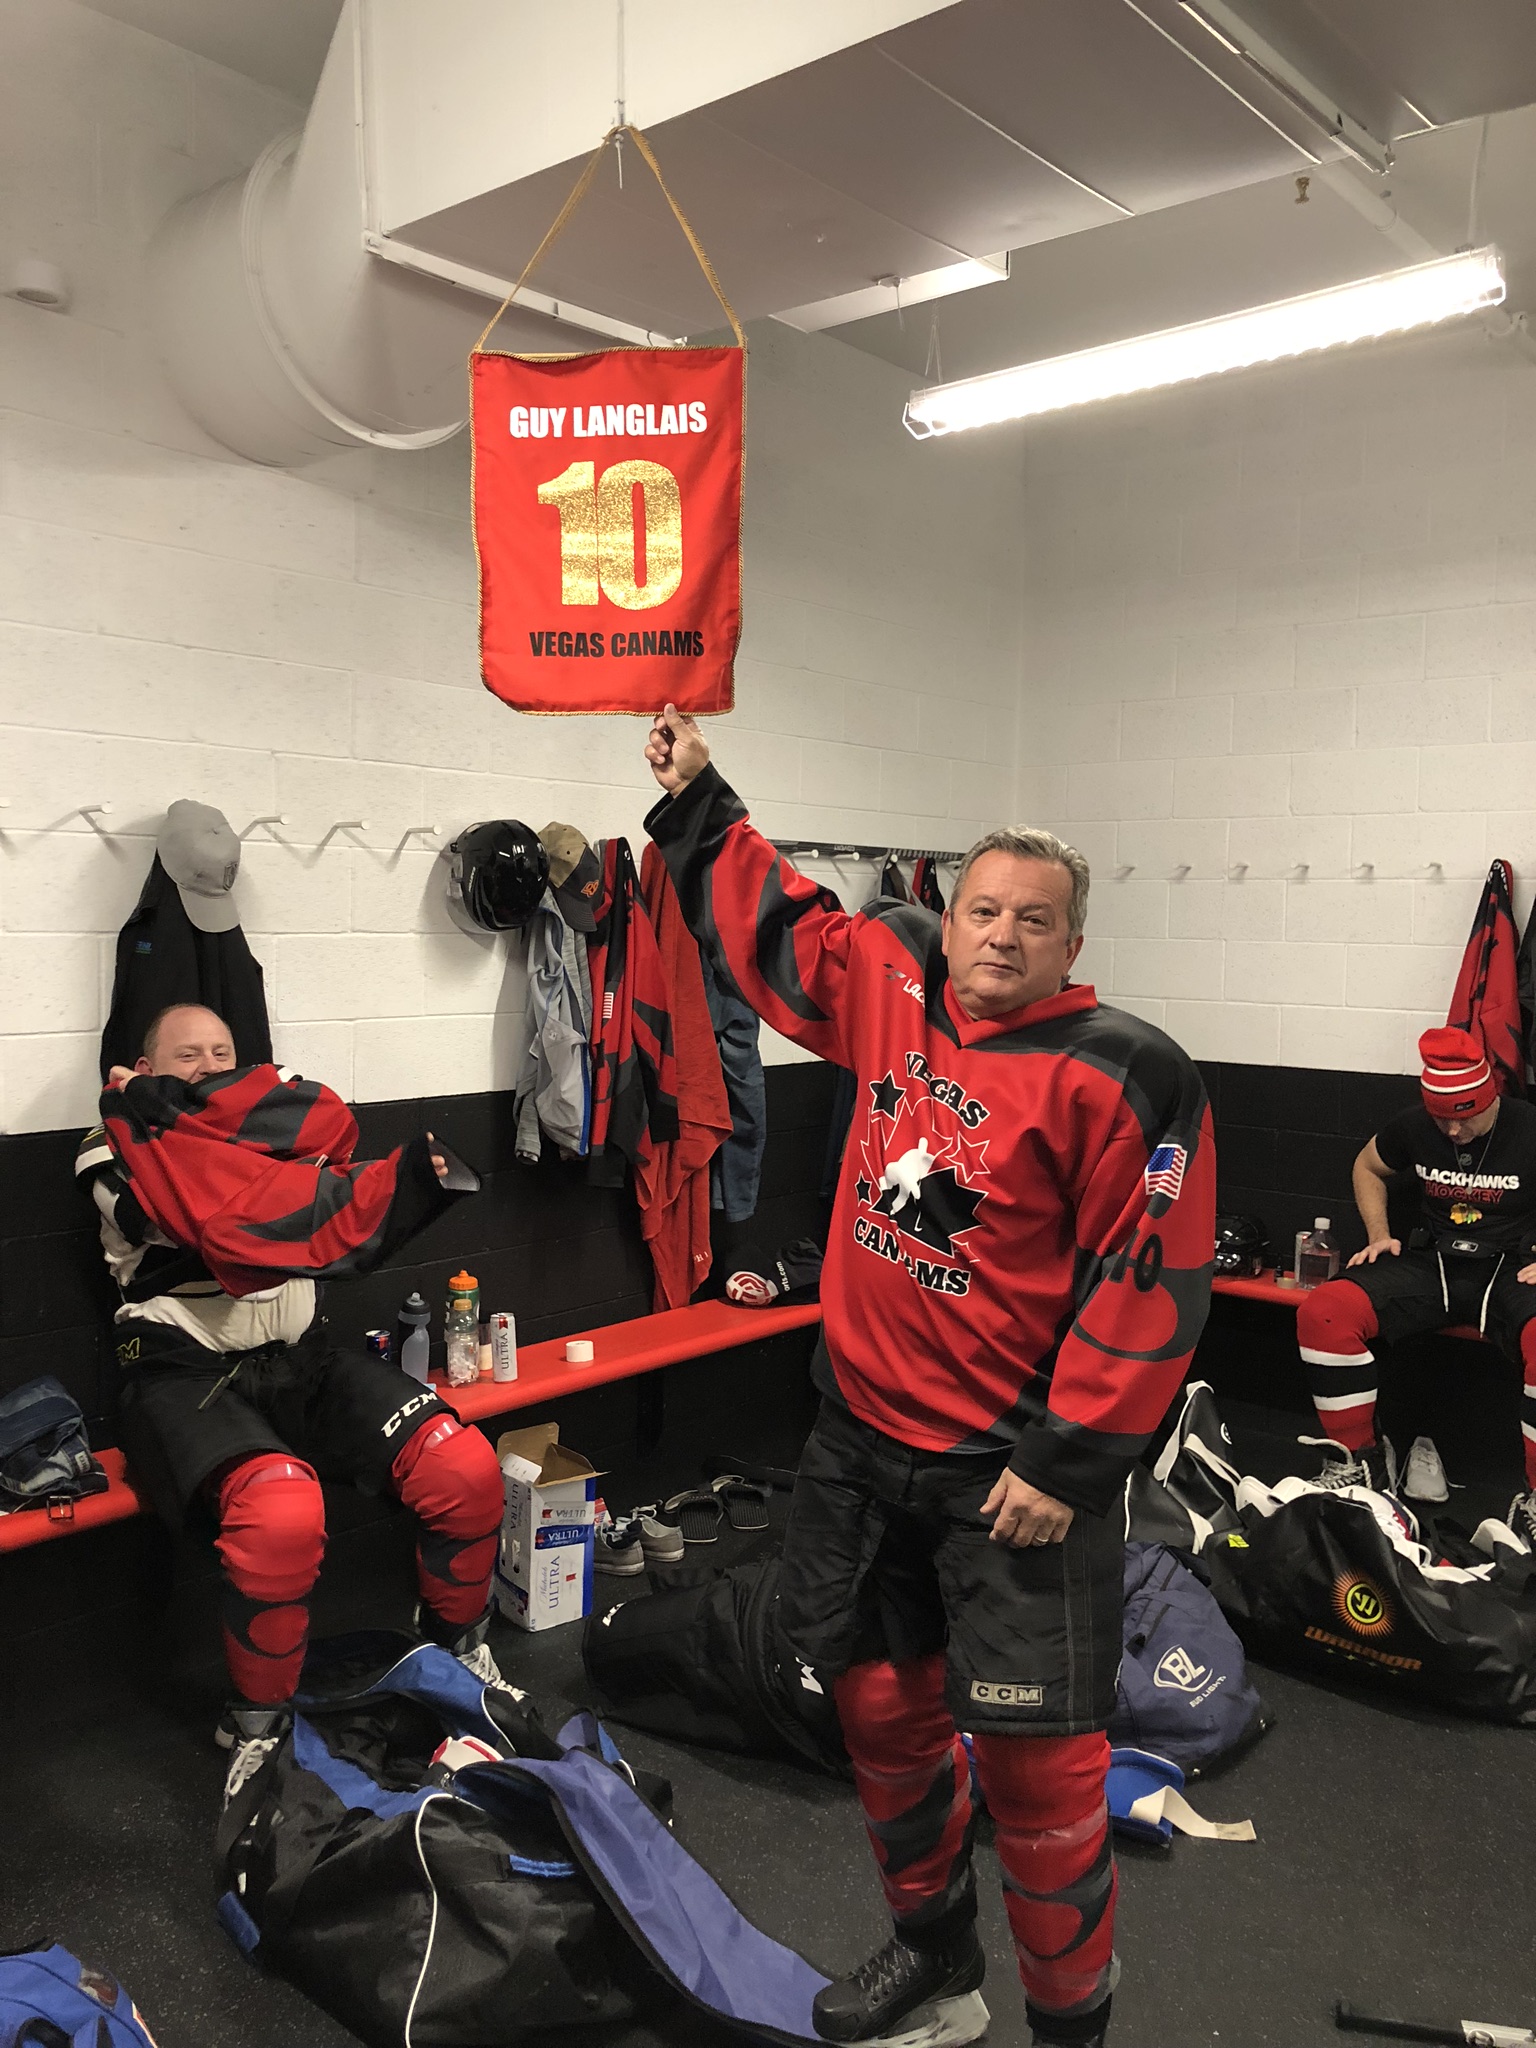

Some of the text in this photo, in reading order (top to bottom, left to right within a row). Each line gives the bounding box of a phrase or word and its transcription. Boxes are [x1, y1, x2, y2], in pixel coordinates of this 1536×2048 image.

[509, 401, 708, 438] GUY LANGLAIS
[537, 459, 683, 611] 10
[529, 630, 705, 658] VEGAS CANAMS
[905, 1051, 990, 1130] VEGAS
[1415, 1163, 1520, 1190] BLACKHAWKS
[1425, 1182, 1503, 1204] HOCKEY
[501, 1332, 509, 1370] ULTRA
[381, 1392, 438, 1438] CCM
[556, 1509, 586, 1518] ULTRA
[548, 1528, 579, 1541] ULTRA
[549, 1555, 560, 1609] ULTRA
[1161, 1647, 1206, 1685] BL
[977, 1685, 1040, 1702] CCM
